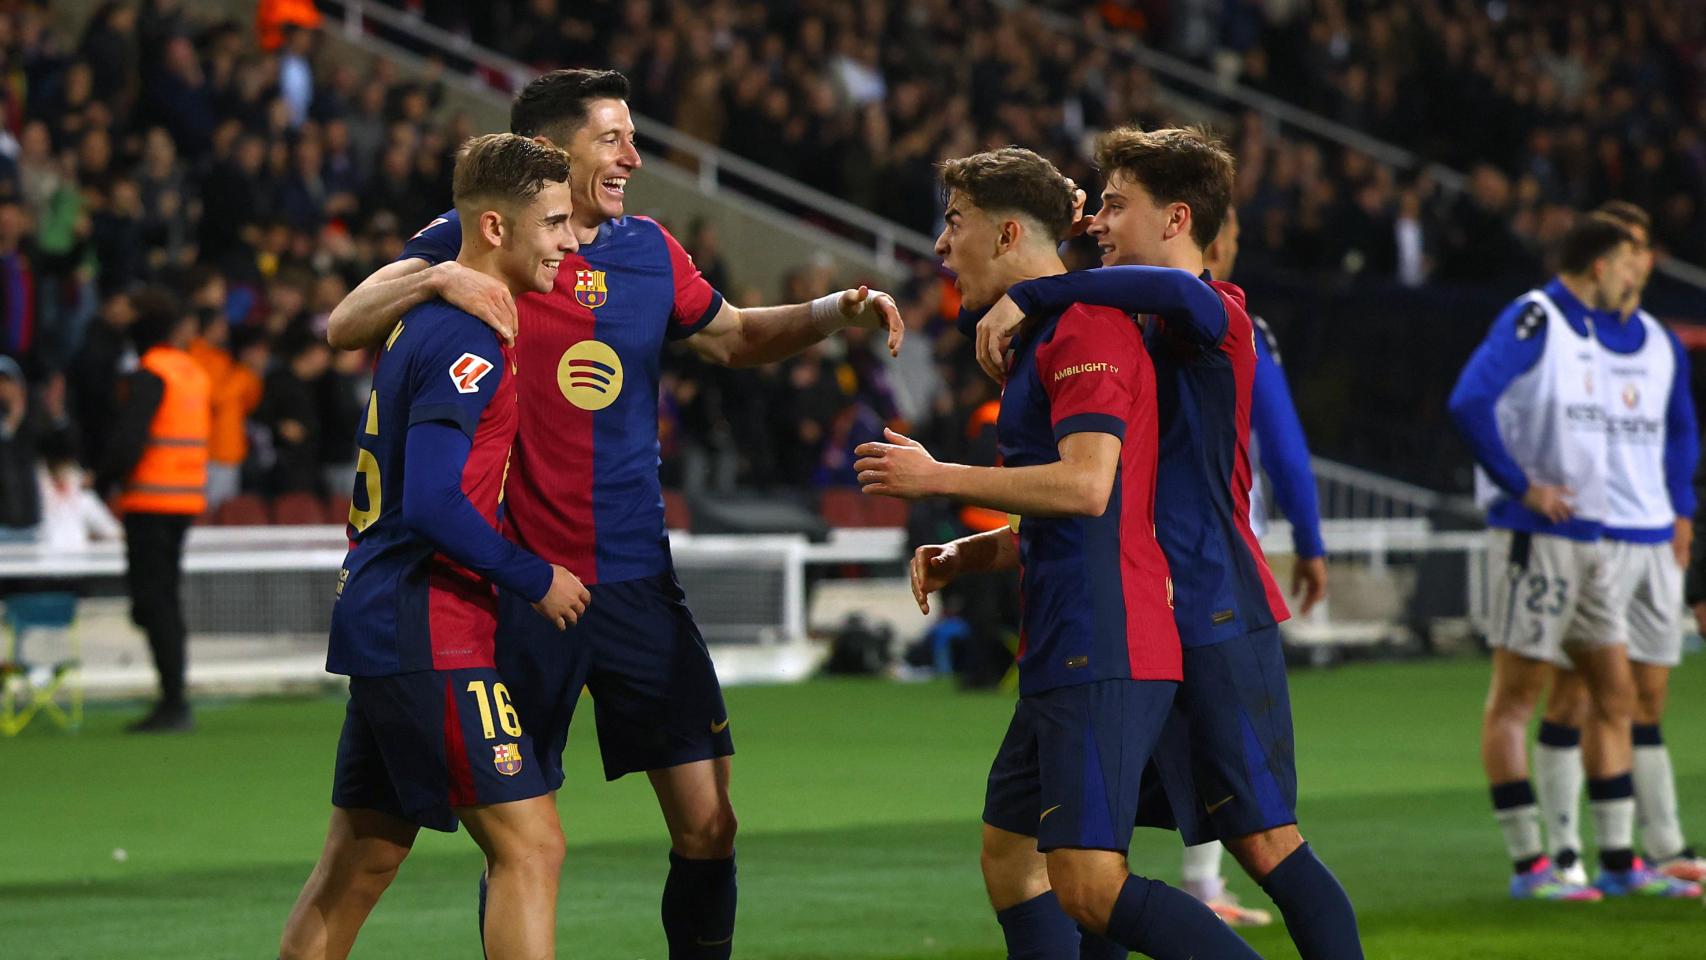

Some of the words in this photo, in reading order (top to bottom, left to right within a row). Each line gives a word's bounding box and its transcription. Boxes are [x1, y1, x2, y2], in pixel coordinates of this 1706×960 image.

[1054, 362, 1107, 382] AMBILIGHT
[1109, 364, 1119, 374] tv
[1526, 575, 1568, 615] 23
[466, 680, 522, 739] 16
